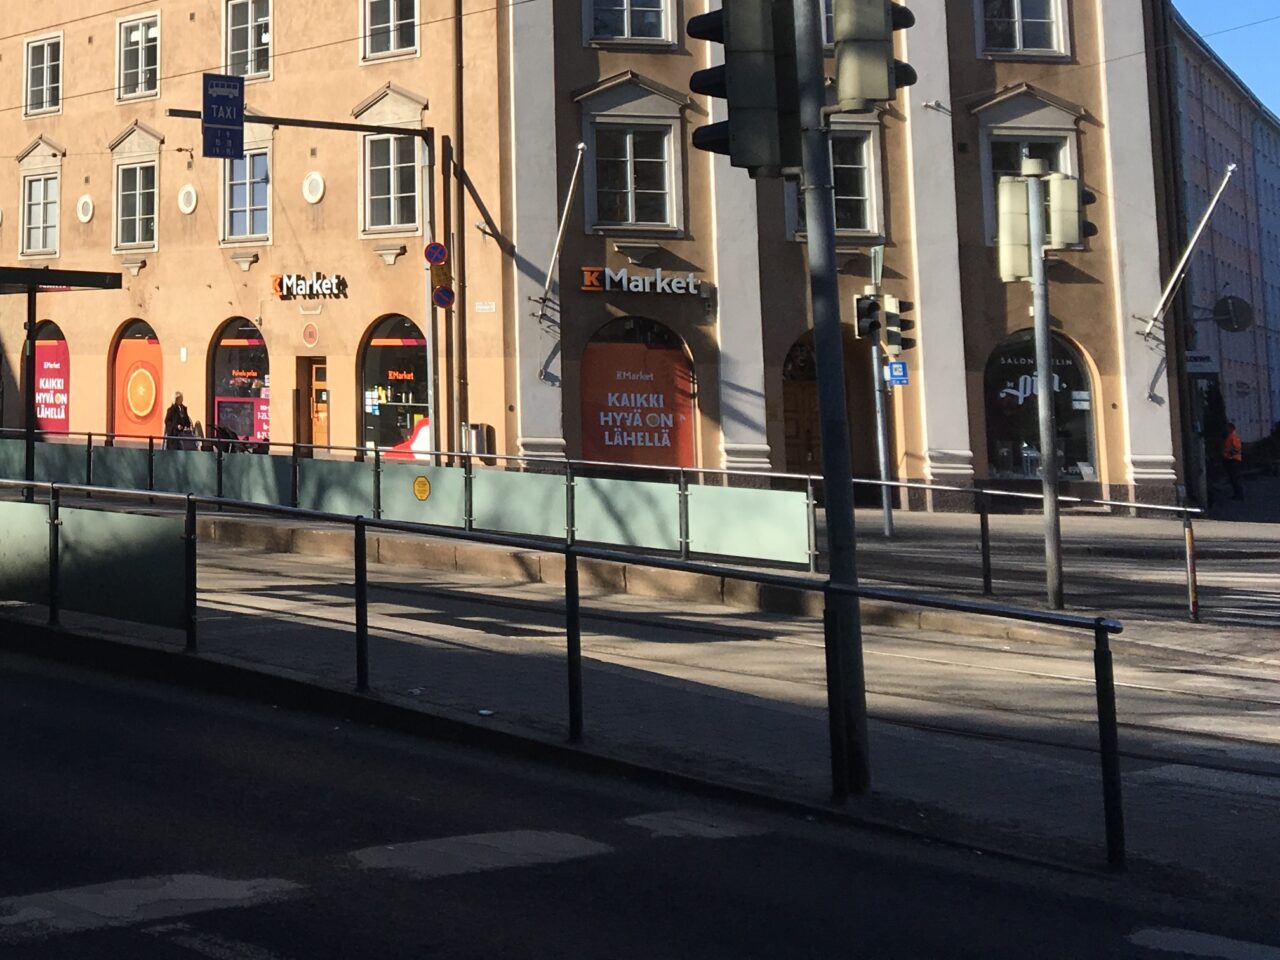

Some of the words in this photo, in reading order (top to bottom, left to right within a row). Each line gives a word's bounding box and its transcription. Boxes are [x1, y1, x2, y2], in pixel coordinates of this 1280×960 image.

[211, 104, 236, 120] TAXI
[1000, 357, 1034, 365] SALON
[39, 378, 64, 390] KAIKKI
[35, 390, 54, 404] HYVÄ
[55, 392, 68, 405] ON
[607, 392, 664, 408] KAIKKI
[36, 404, 66, 419] LÄHELLÄ
[600, 409, 643, 427] HYVÄ
[646, 413, 673, 427] ON
[604, 427, 671, 447] LÄHELLÄ
